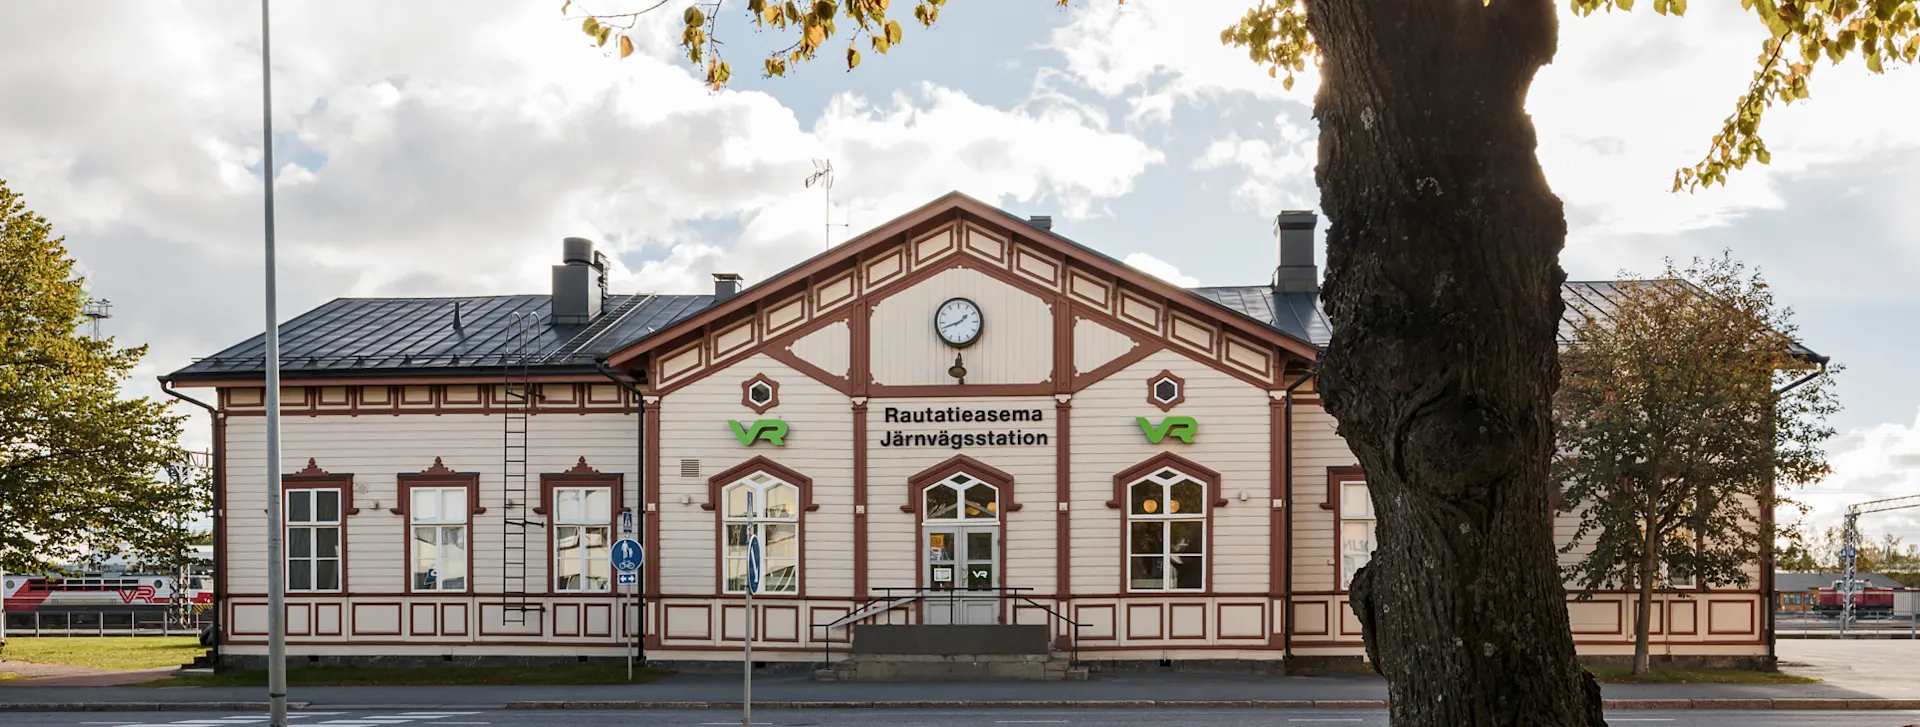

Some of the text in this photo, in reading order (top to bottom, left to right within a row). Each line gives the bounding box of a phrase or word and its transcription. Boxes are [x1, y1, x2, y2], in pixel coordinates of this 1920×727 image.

[884, 406, 1043, 424] Rautatieasema
[728, 419, 788, 446] VR
[880, 428, 1048, 450] Järnvägsstation
[1136, 416, 1199, 443] VR
[972, 570, 988, 579] VR
[118, 585, 156, 604] VR
